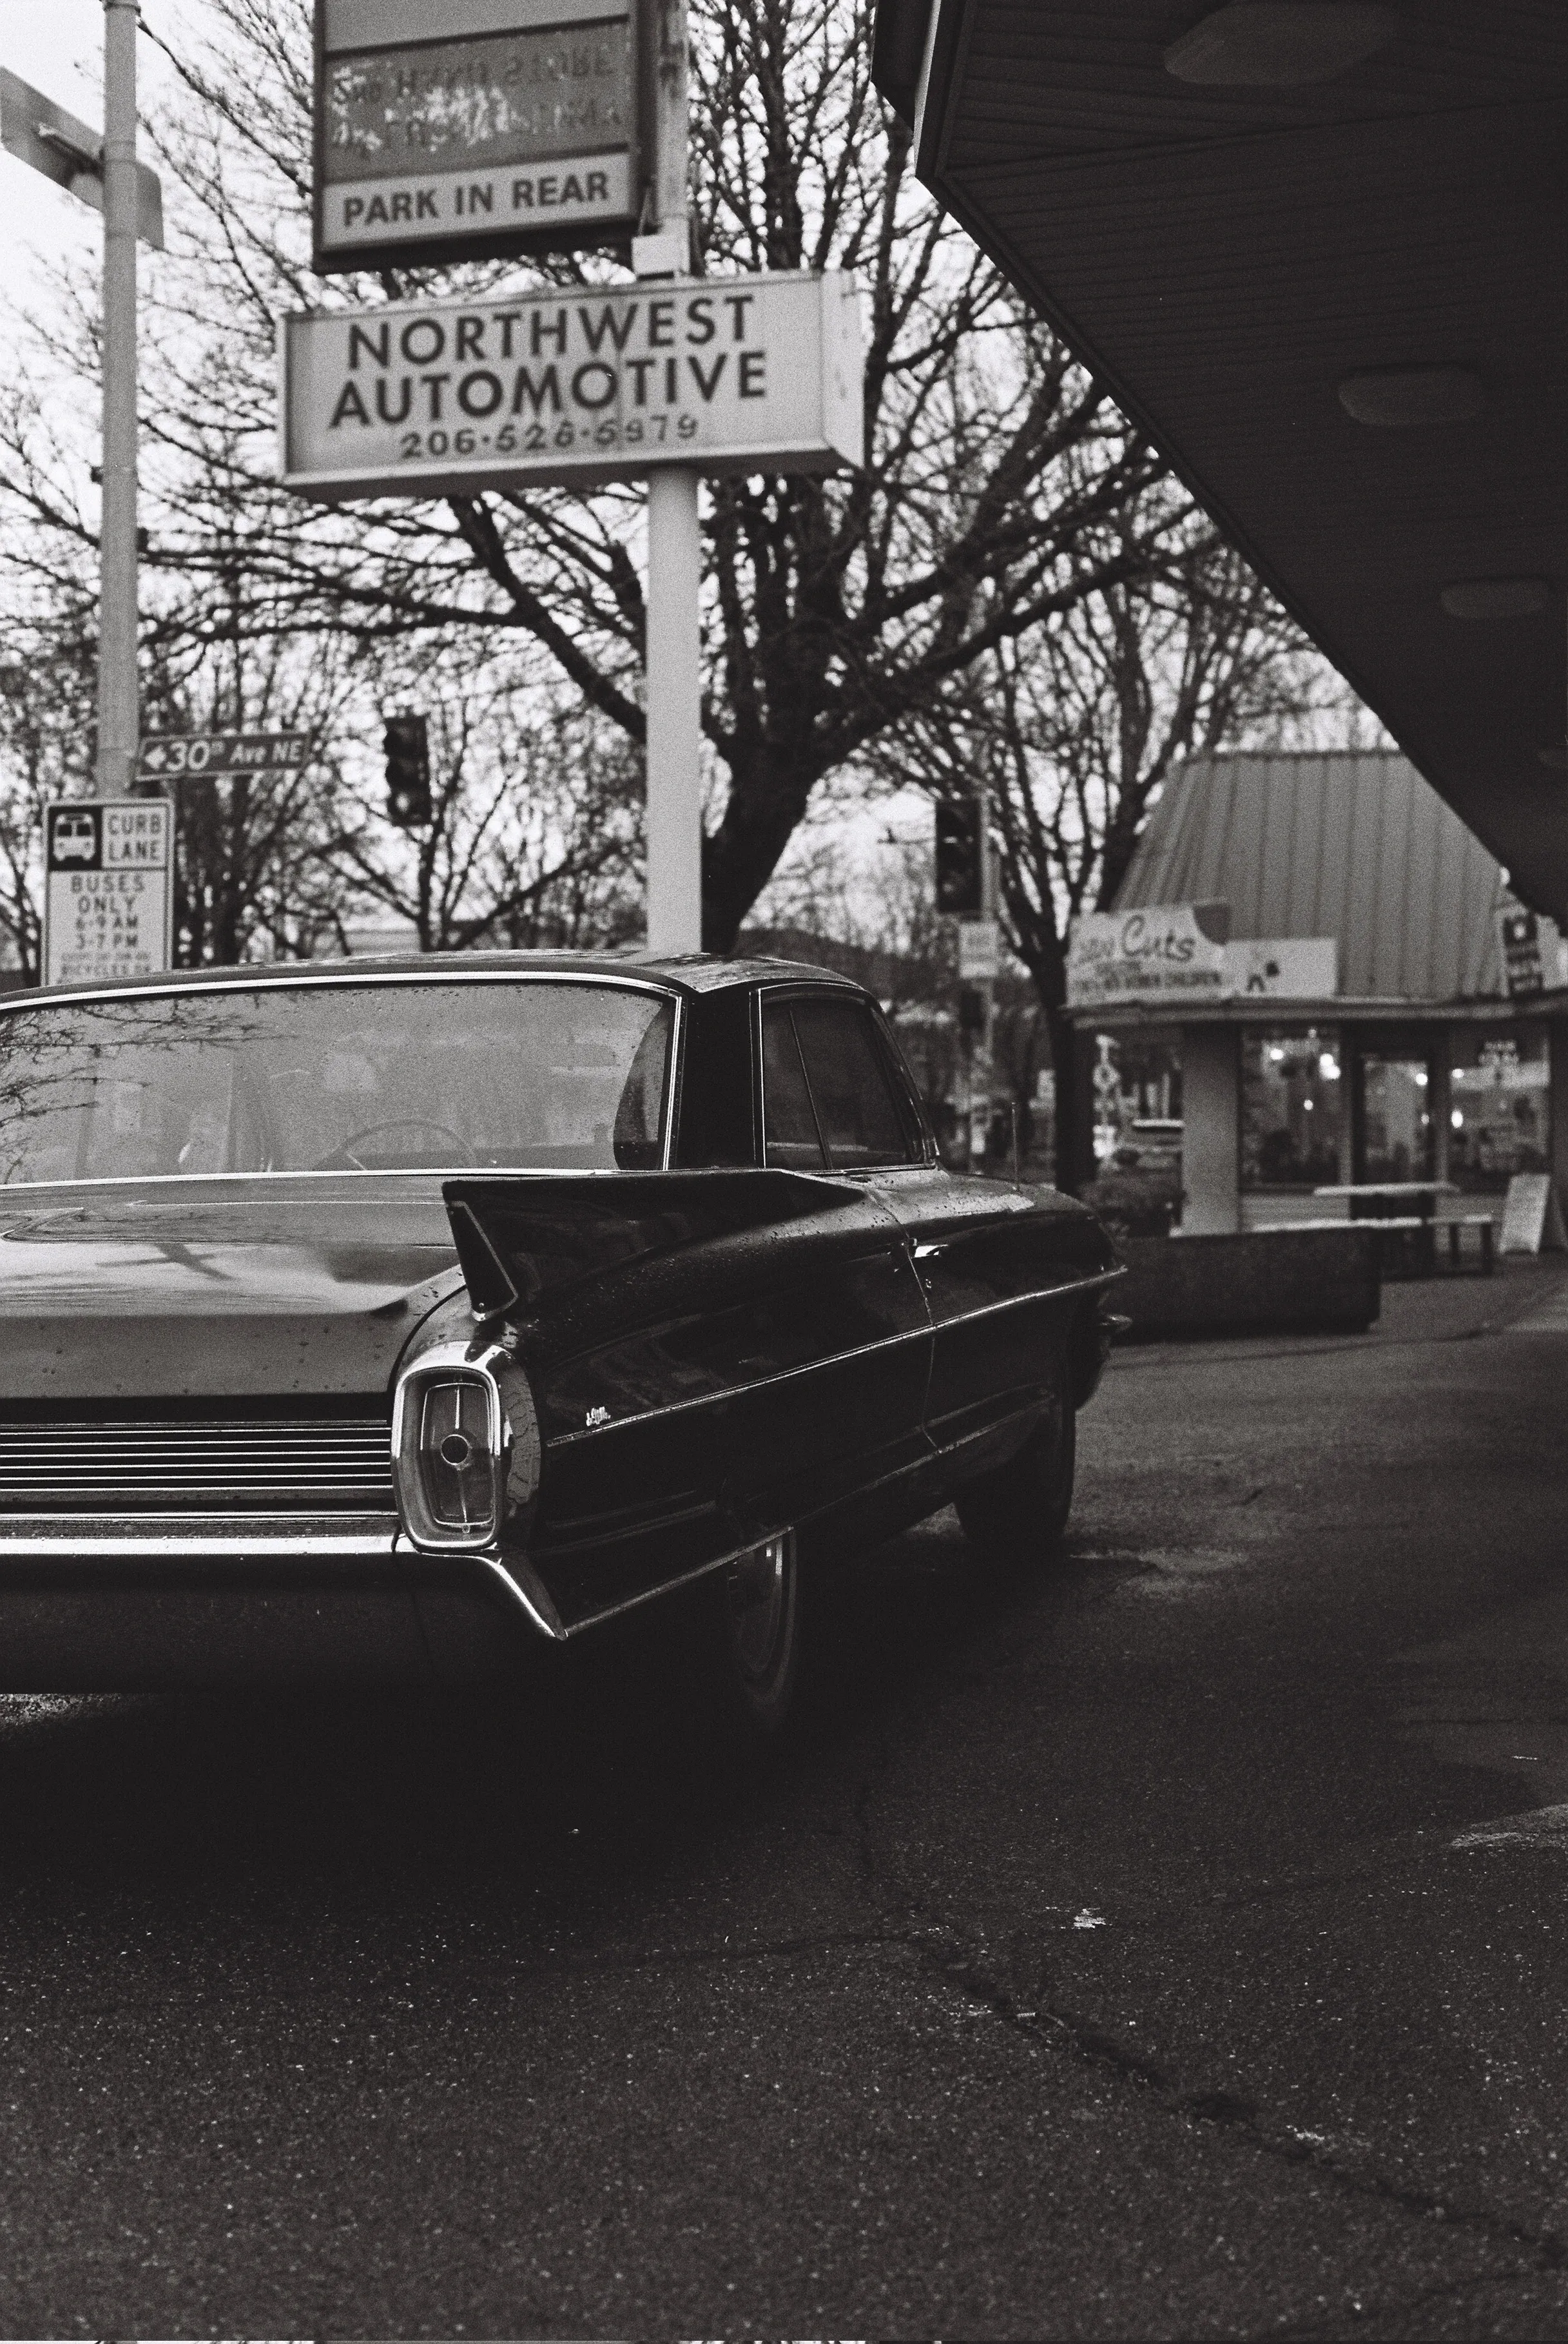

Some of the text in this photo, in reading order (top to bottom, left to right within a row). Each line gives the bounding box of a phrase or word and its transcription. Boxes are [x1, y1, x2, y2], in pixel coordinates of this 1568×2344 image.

[343, 171, 608, 228] PARK IN REAR
[348, 295, 755, 371] NORTHWEST
[329, 351, 768, 430] AUTOMOTIVE
[272, 741, 302, 763] NE
[107, 813, 161, 836] CURB
[108, 839, 160, 862] LANE
[70, 874, 146, 894] BUSES
[78, 894, 137, 915] ONLY
